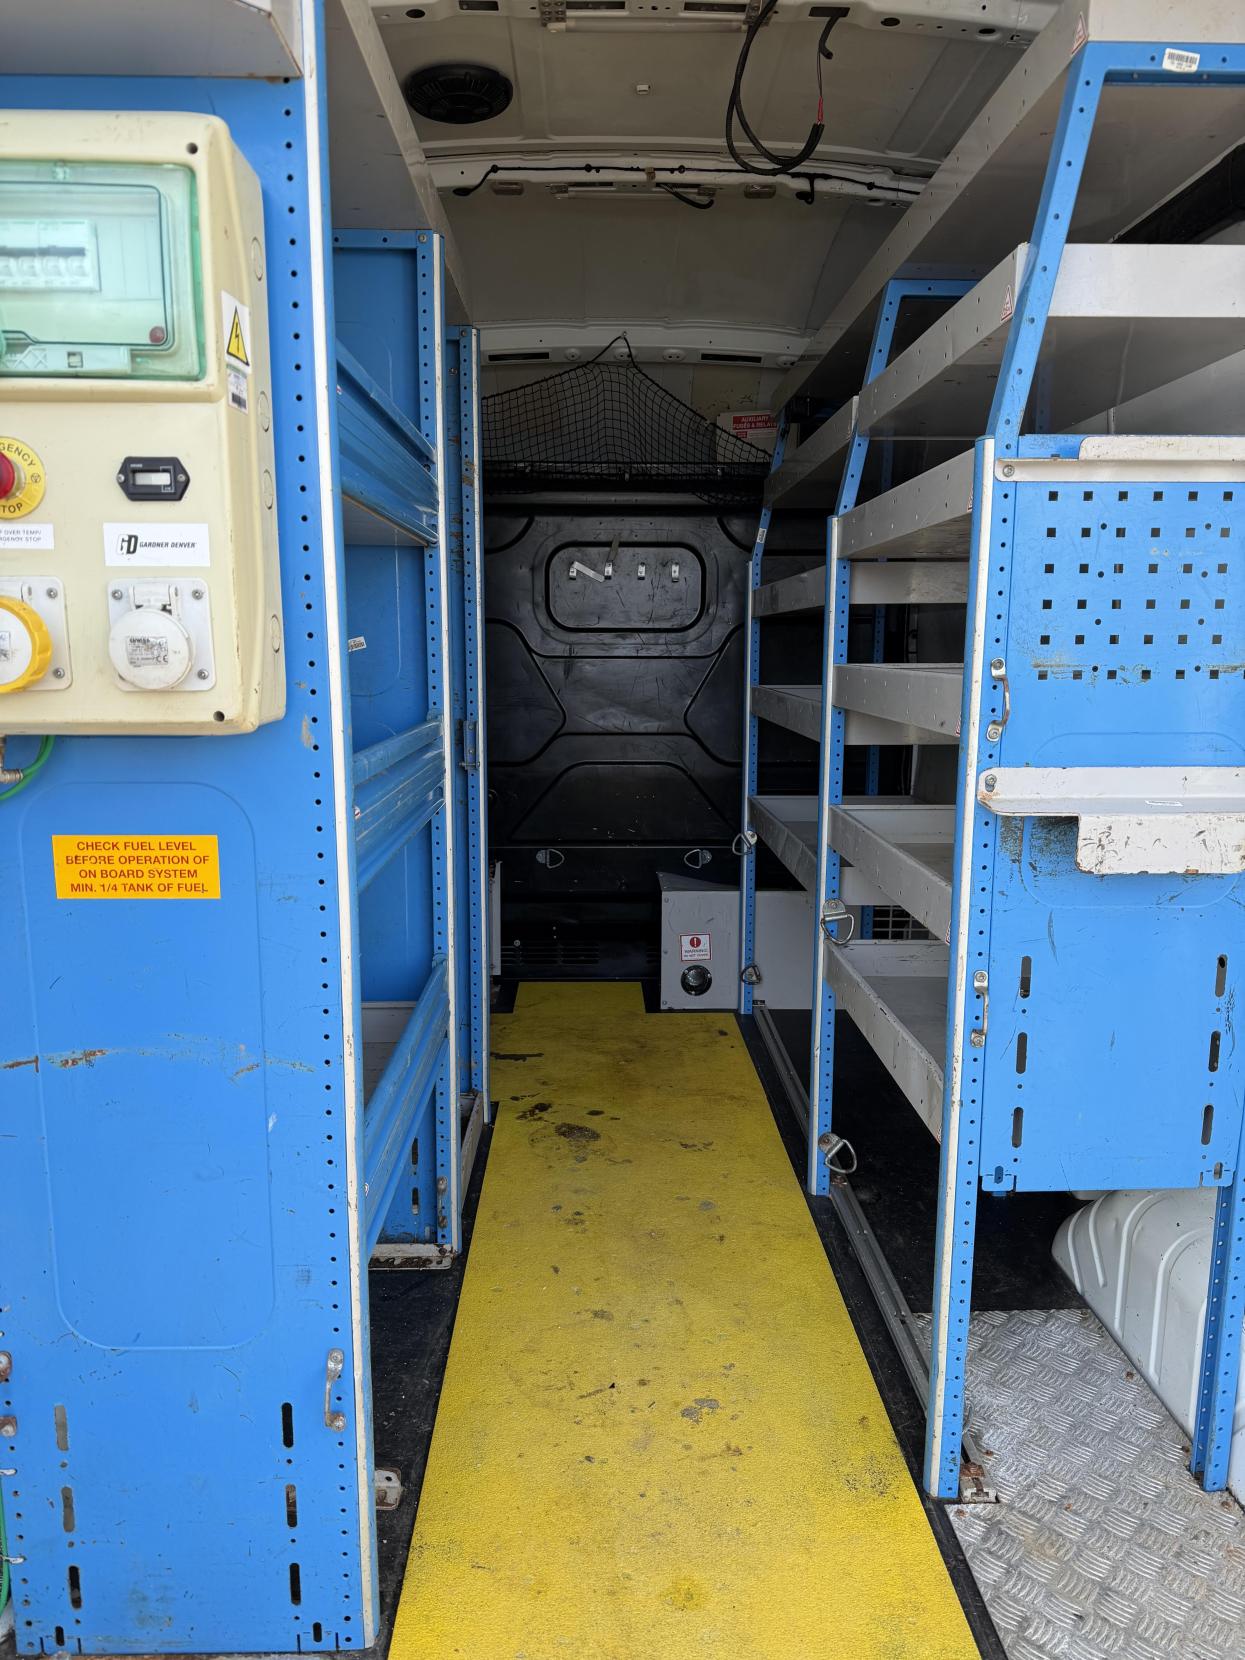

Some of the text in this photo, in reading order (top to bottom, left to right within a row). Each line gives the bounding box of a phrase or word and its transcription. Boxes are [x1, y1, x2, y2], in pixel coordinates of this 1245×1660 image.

[77, 841, 197, 851] CHECK FUEL LEVEL
[66, 855, 210, 865] BEFORE OPERATION OF
[79, 869, 198, 879] ON BOARD SYSTEM
[70, 883, 208, 893] MIN. 1/4 TANK OF FUEL
